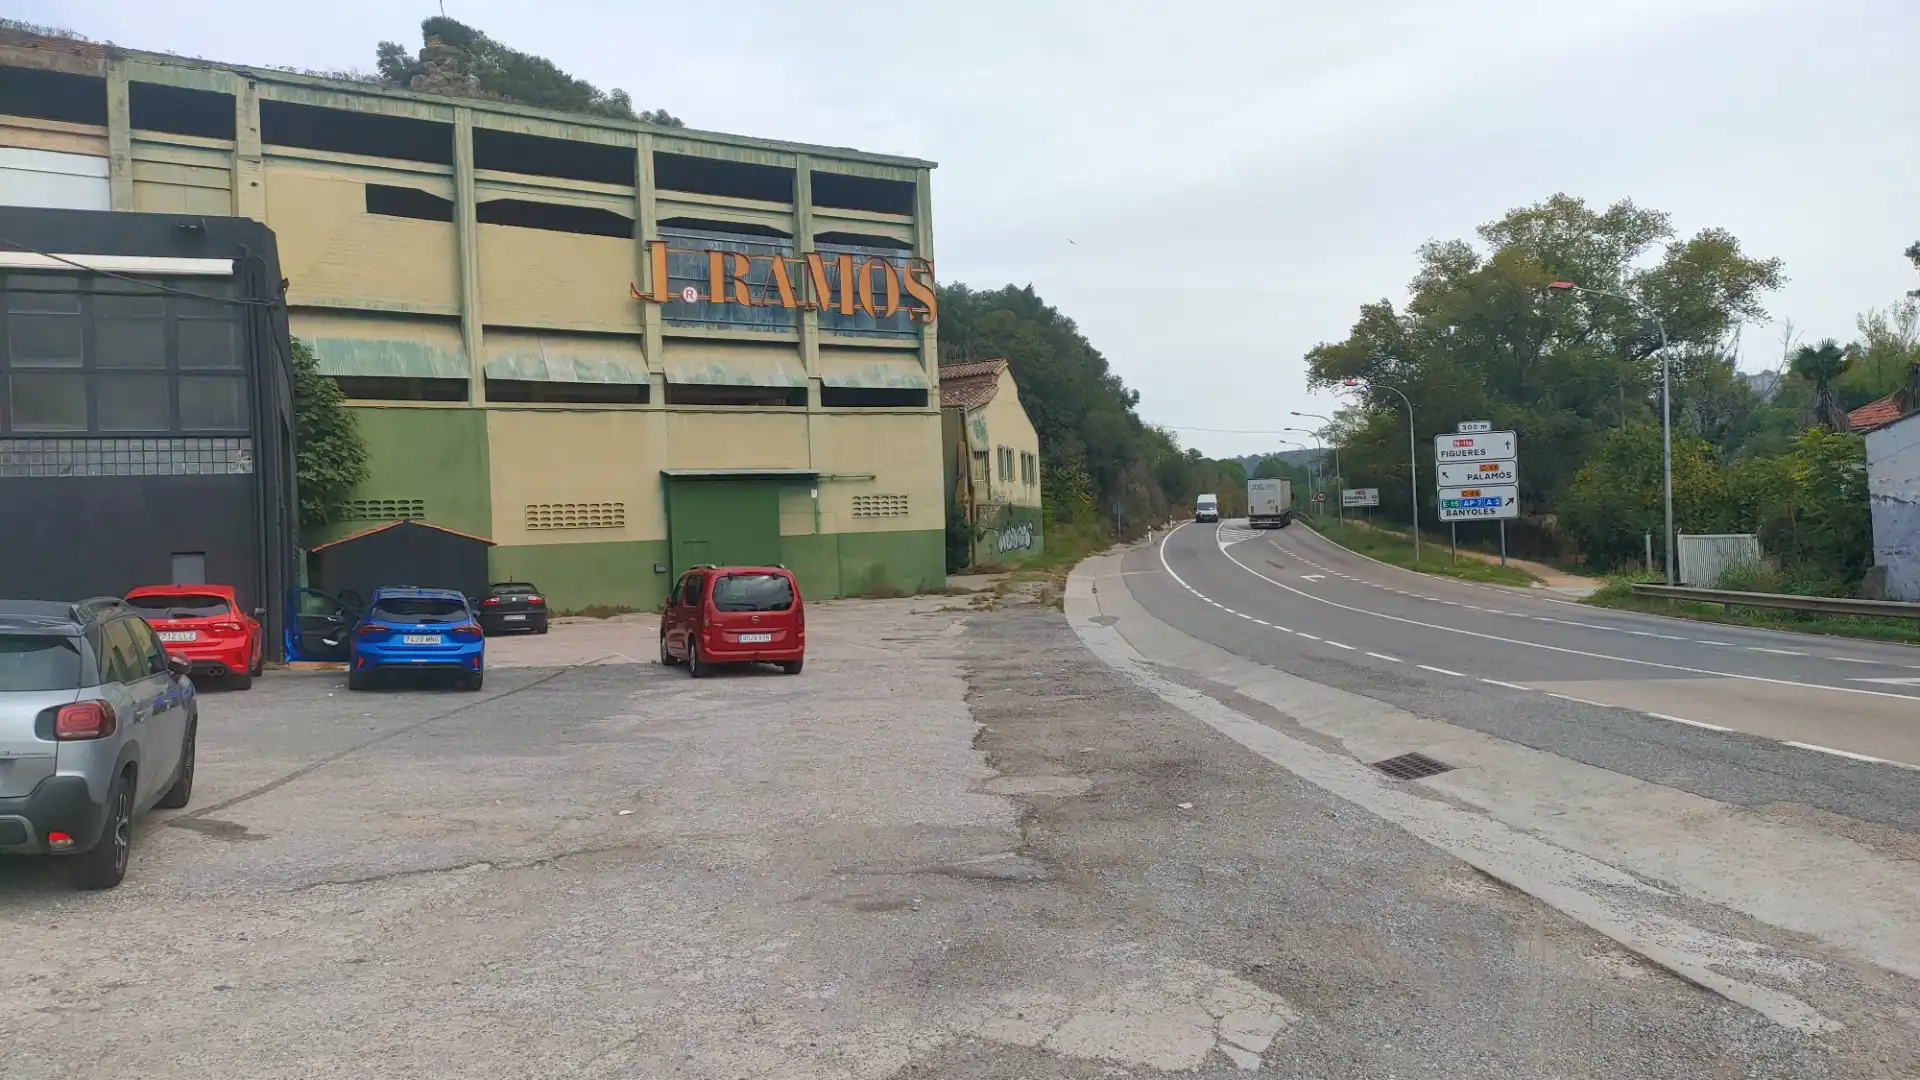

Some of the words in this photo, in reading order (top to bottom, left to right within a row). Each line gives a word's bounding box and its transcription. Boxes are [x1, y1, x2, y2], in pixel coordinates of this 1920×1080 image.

[706, 250, 937, 324] RAMOS
[1441, 449, 1486, 457] FIGUERES
[1467, 471, 1511, 480] PALAMÓS
[1446, 508, 1496, 516] BANYOLES
